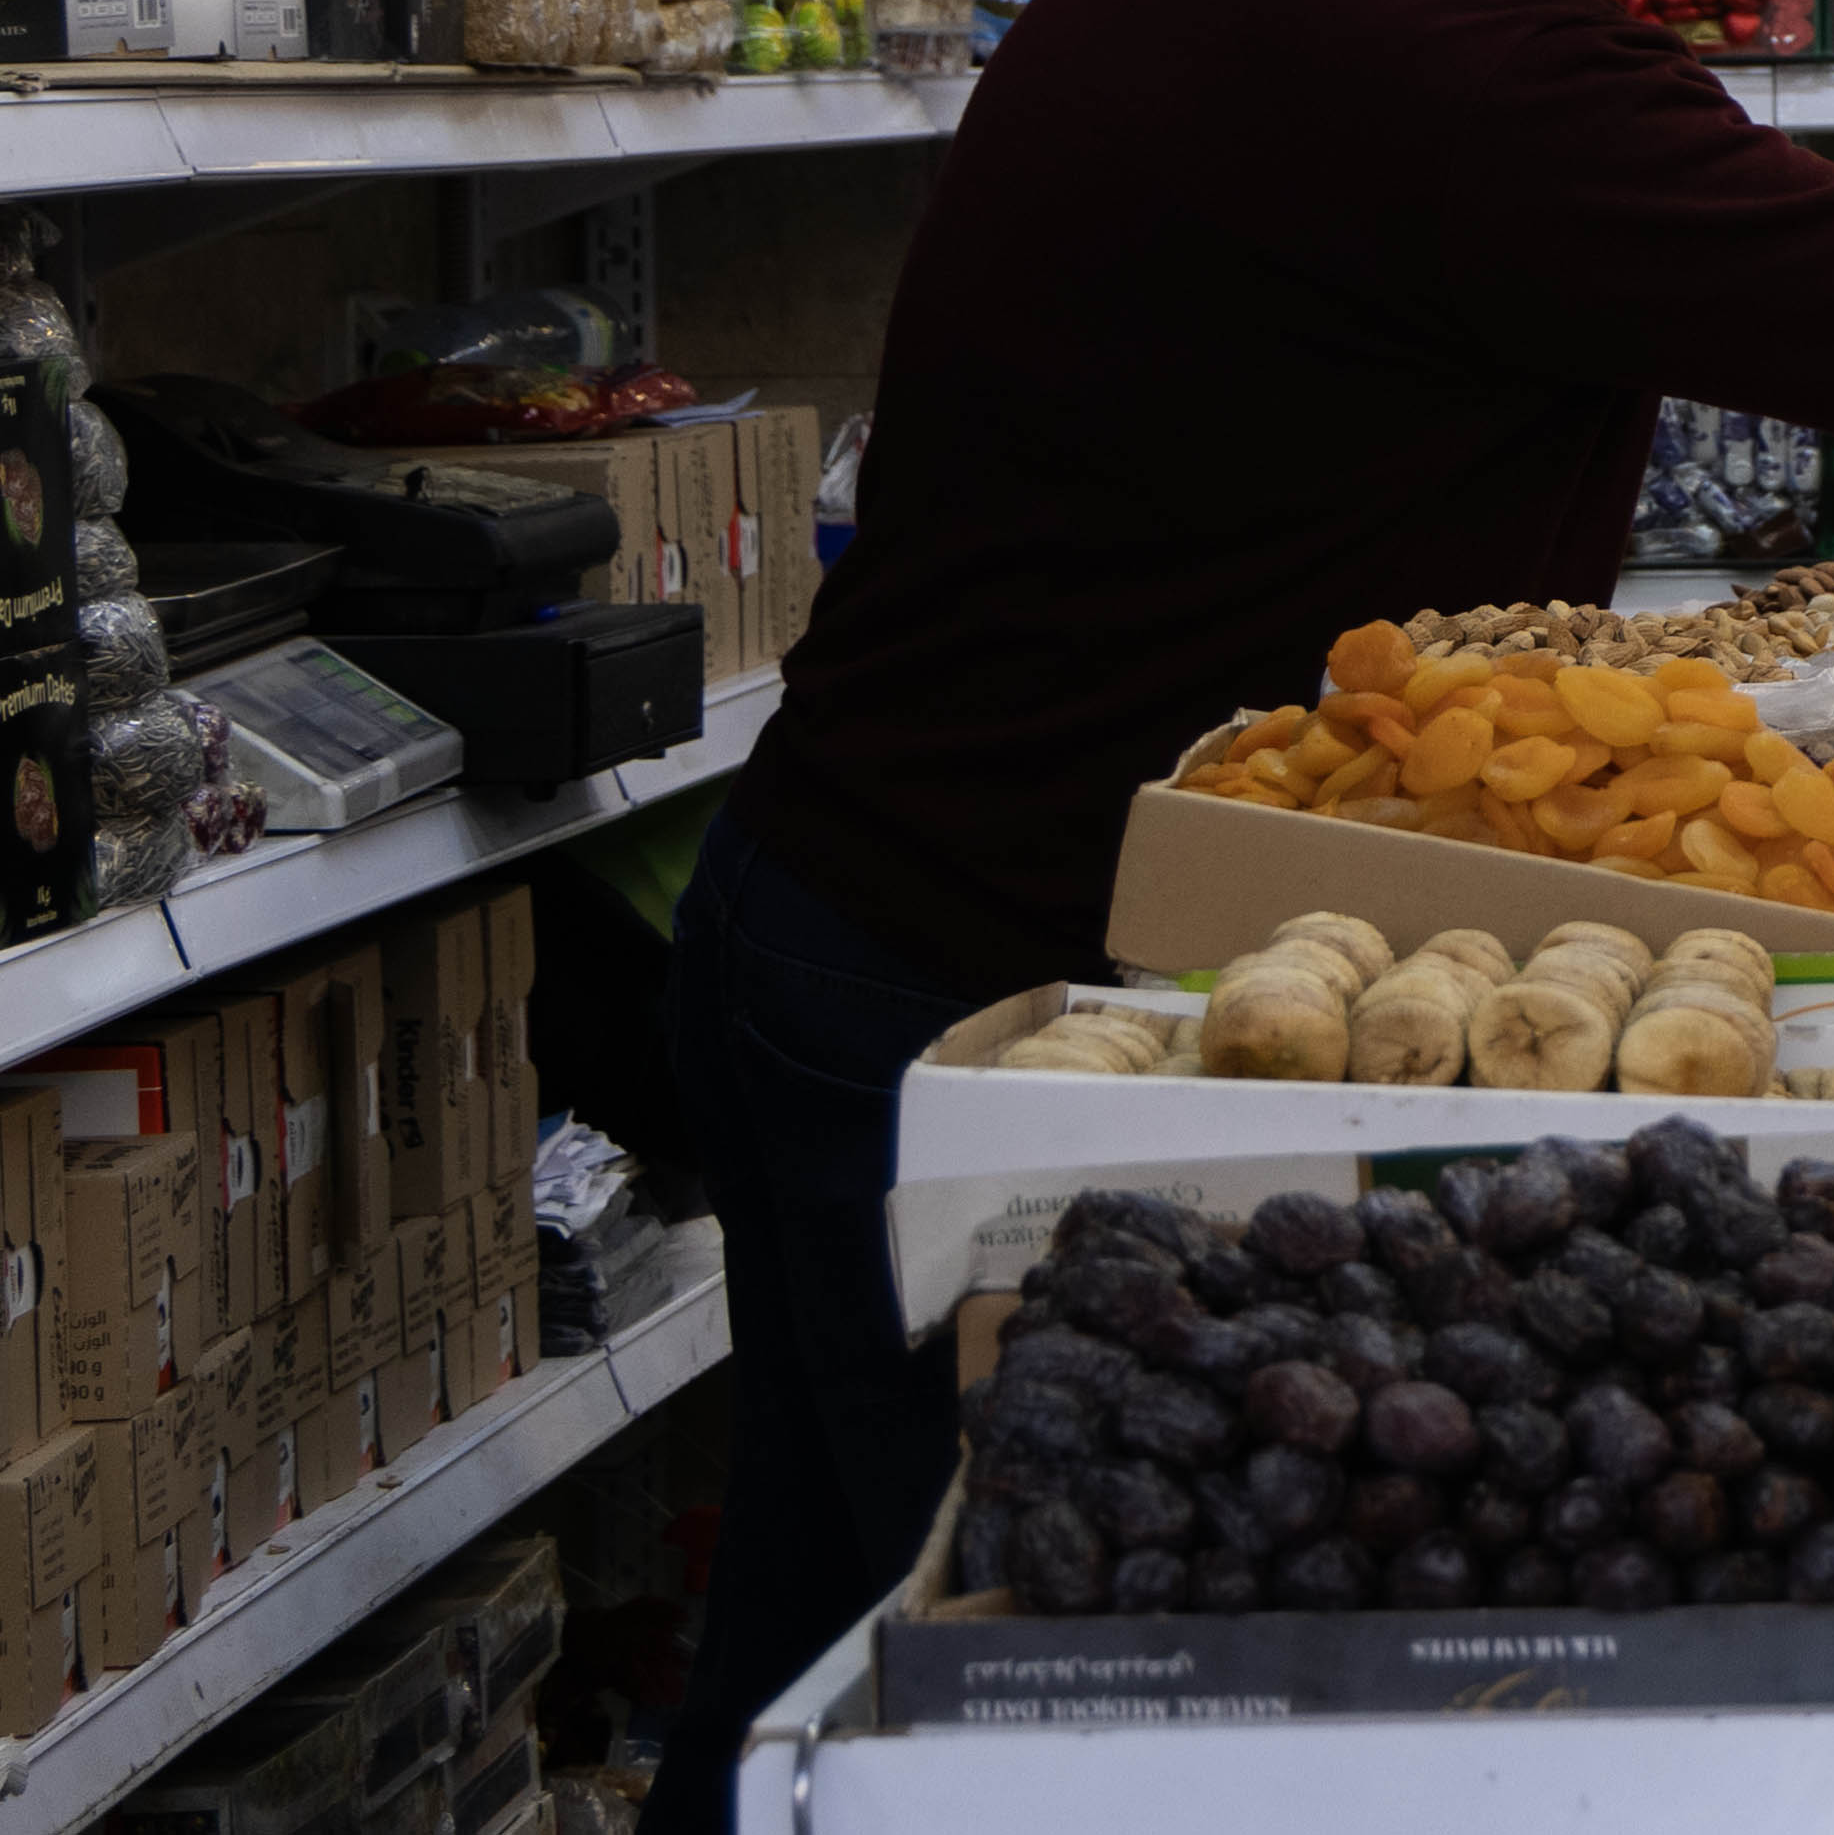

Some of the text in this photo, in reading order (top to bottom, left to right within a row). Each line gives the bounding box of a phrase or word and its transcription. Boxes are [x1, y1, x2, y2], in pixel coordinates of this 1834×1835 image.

[12, 575, 64, 621] Premium
[46, 672, 76, 707] Dates
[396, 1018, 424, 1110] Kinder
[976, 1226, 1051, 1248] eigen
[961, 1695, 1292, 1724] NATURAL MEDJOUL DATES
